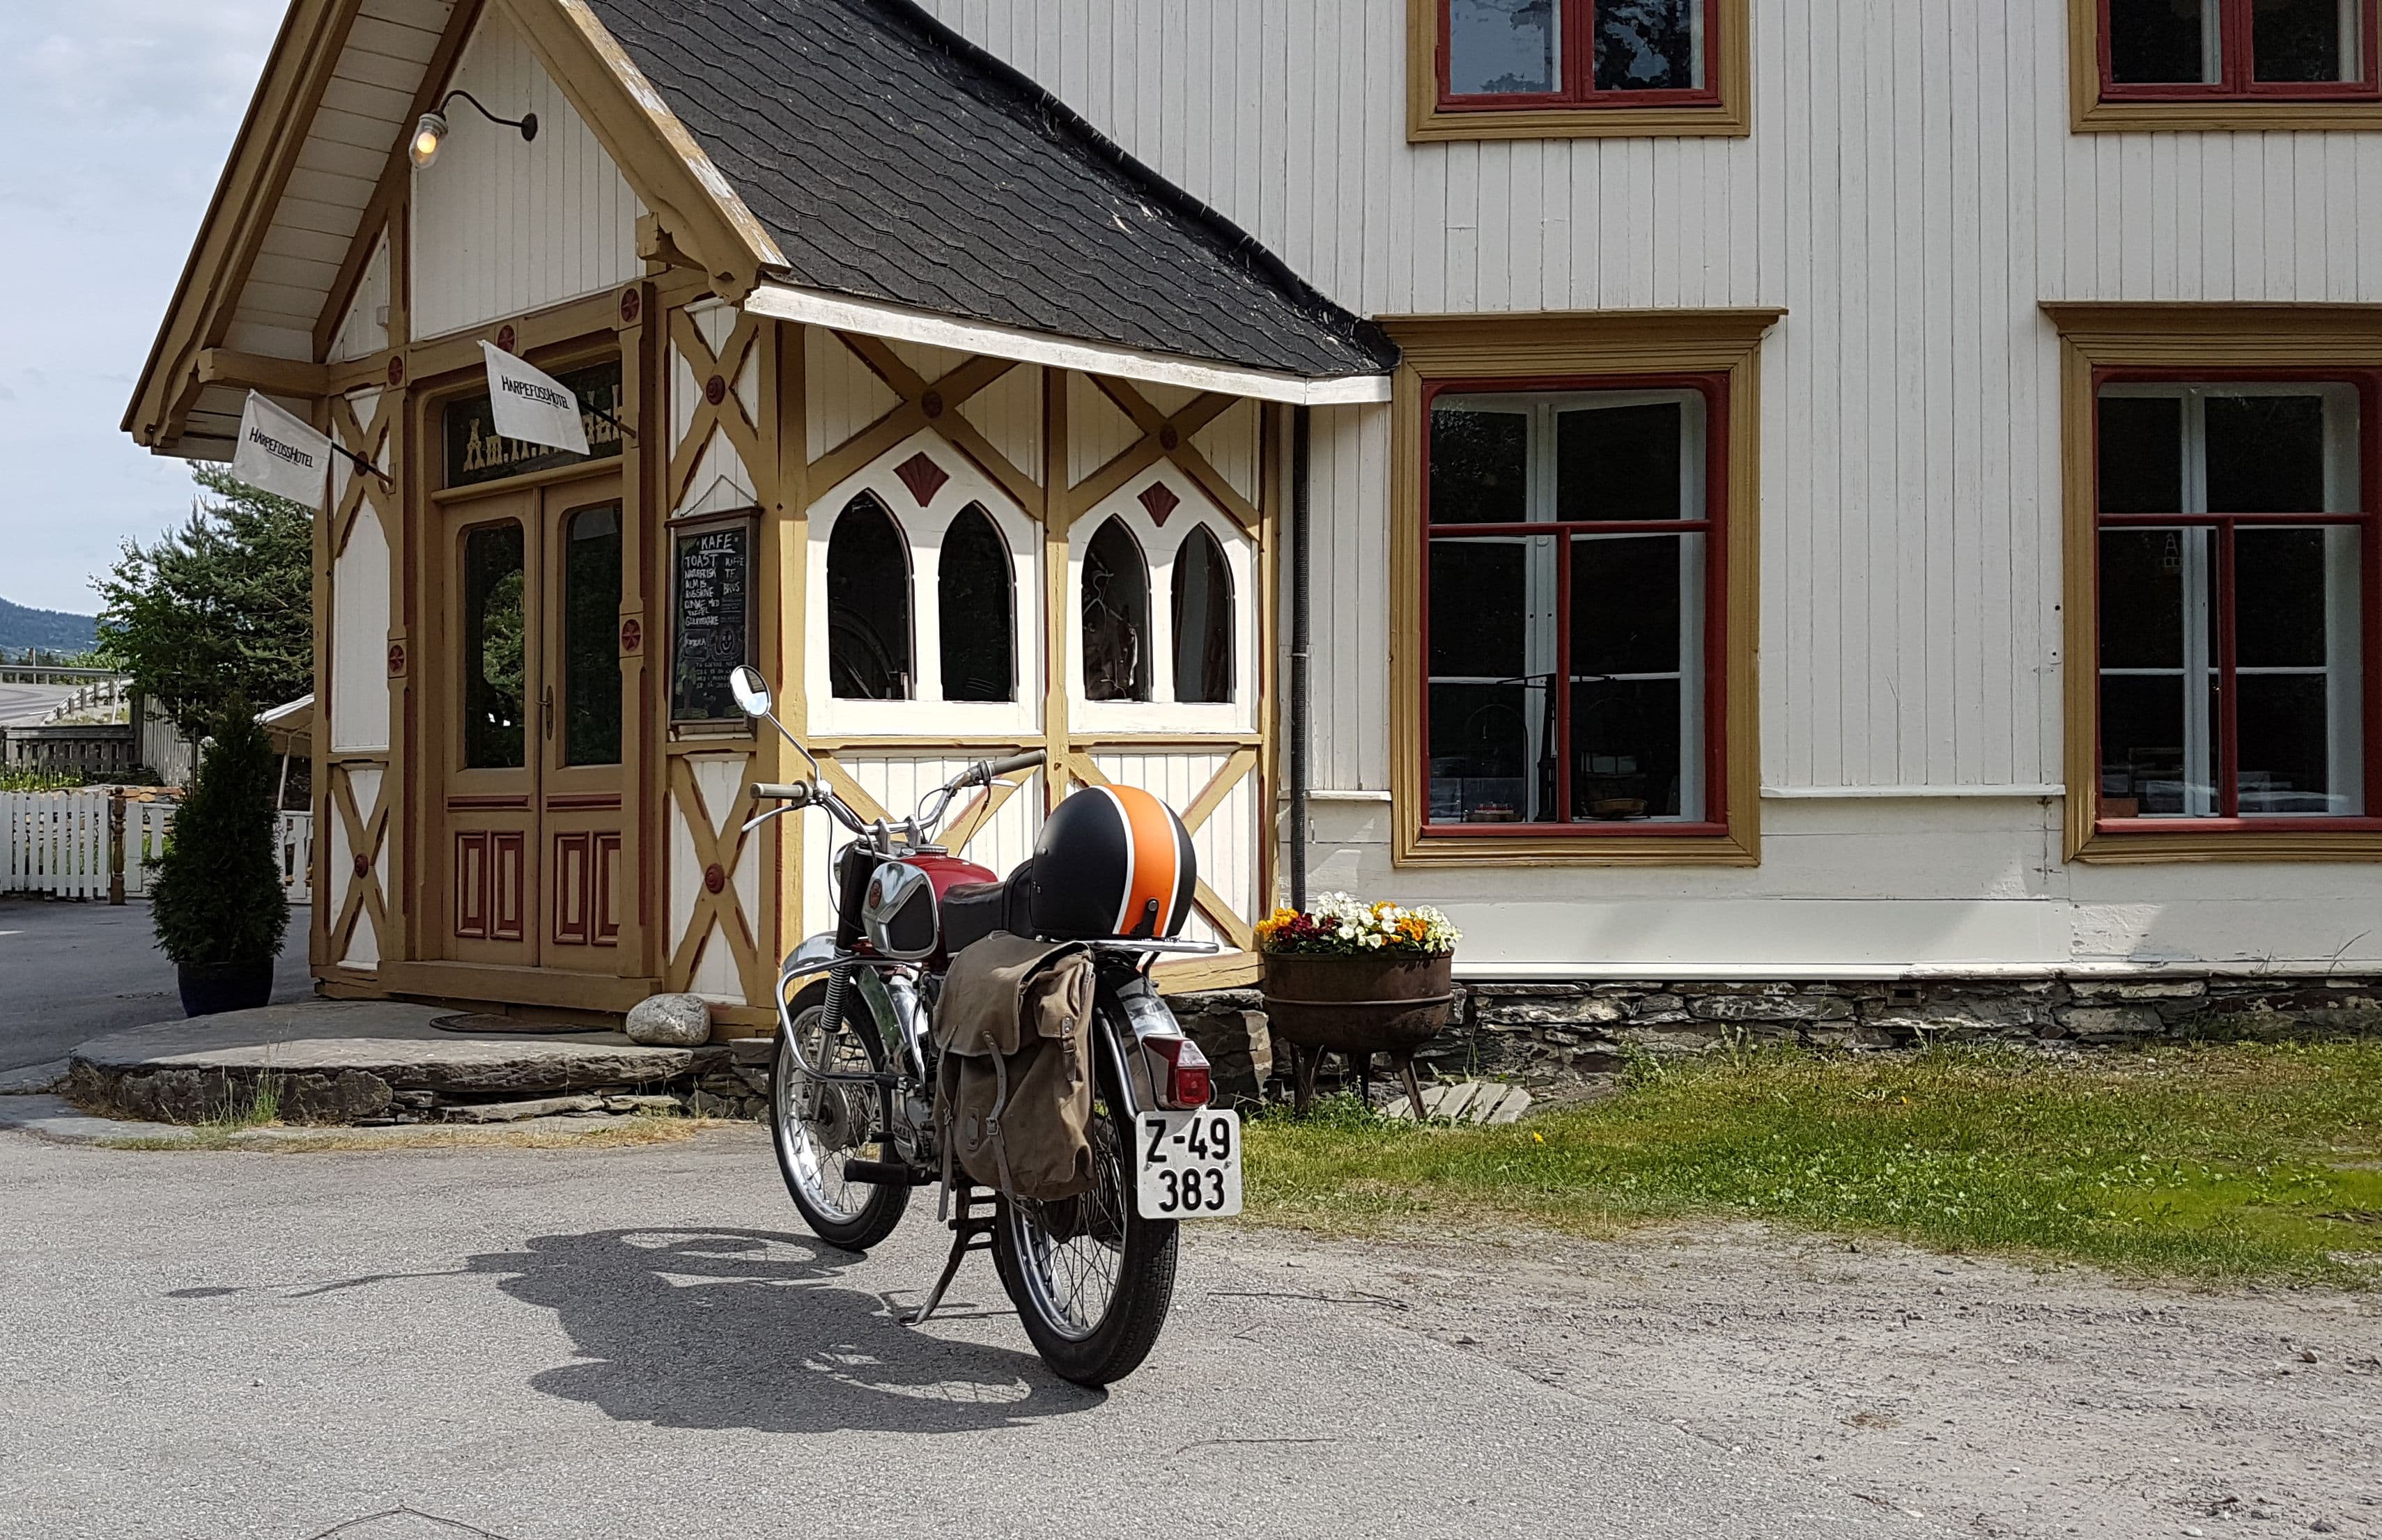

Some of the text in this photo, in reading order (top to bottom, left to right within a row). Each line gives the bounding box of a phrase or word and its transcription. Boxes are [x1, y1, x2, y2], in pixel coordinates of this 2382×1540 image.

[701, 533, 733, 550] KAFE
[684, 554, 719, 568] TOAST
[725, 568, 736, 579] TE
[1145, 1117, 1231, 1162] Z-49
[1158, 1167, 1225, 1213] 383
